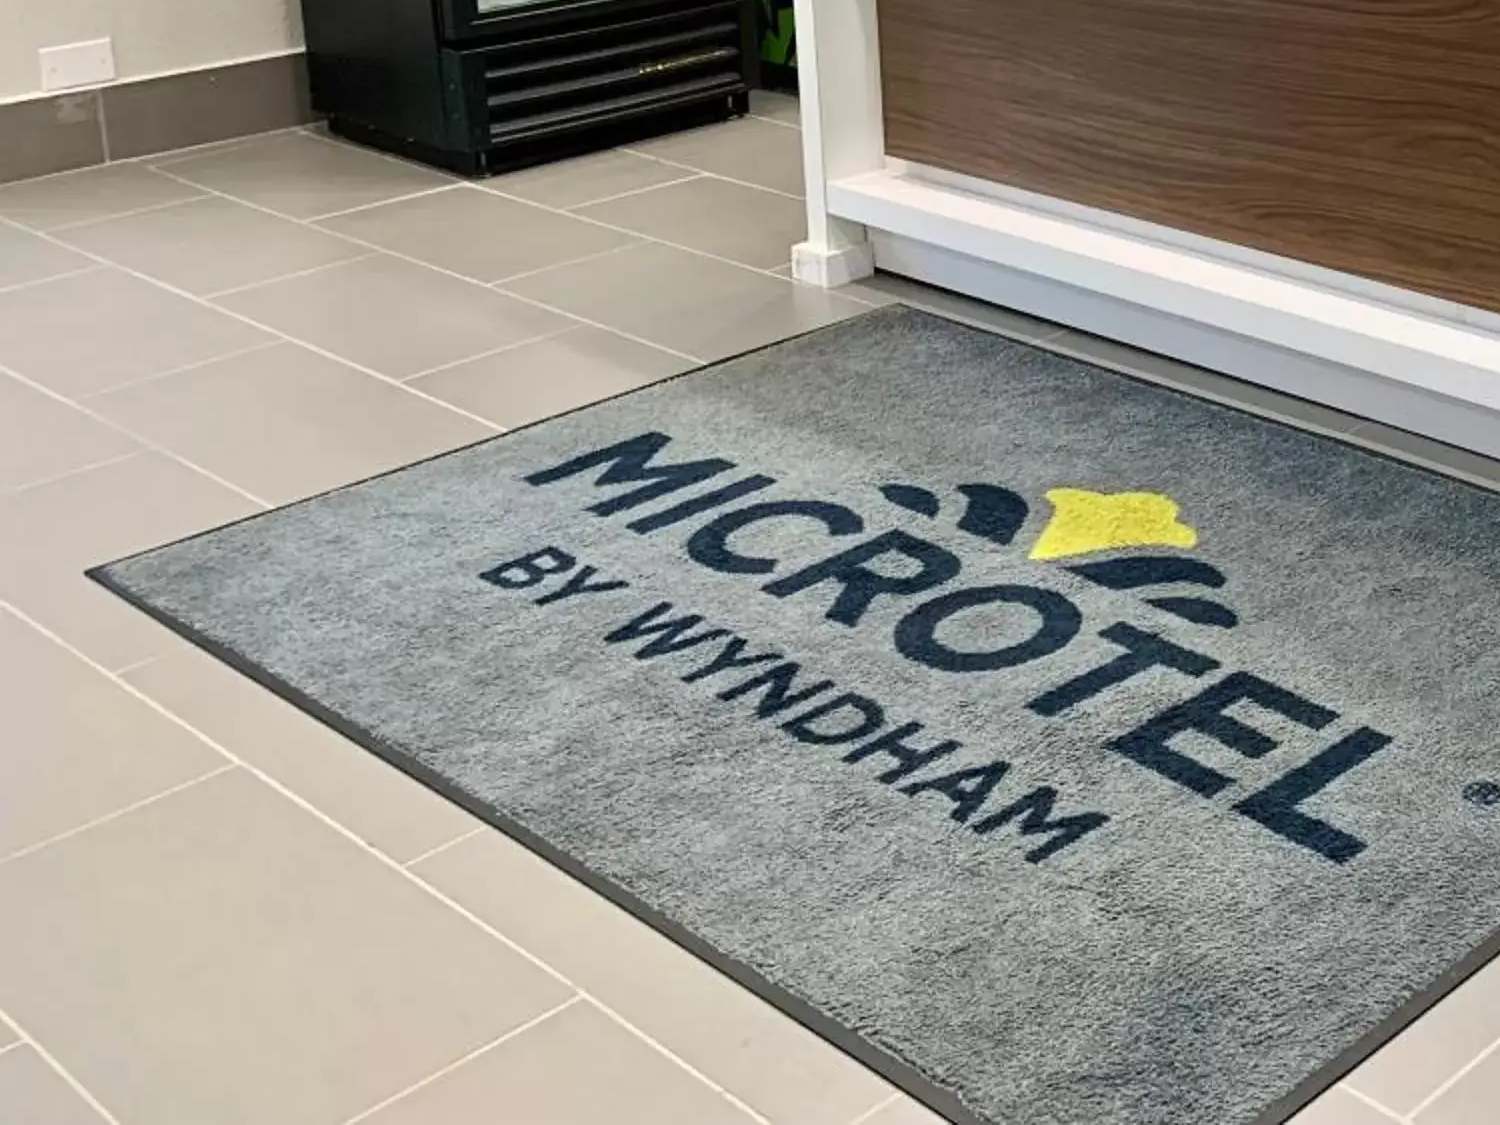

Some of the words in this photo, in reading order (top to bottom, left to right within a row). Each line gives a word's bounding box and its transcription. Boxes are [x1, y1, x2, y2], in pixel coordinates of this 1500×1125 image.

[480, 545, 630, 607] BY
[602, 600, 1111, 865] WYNDHAM
[524, 431, 1394, 865] MICROTEL
